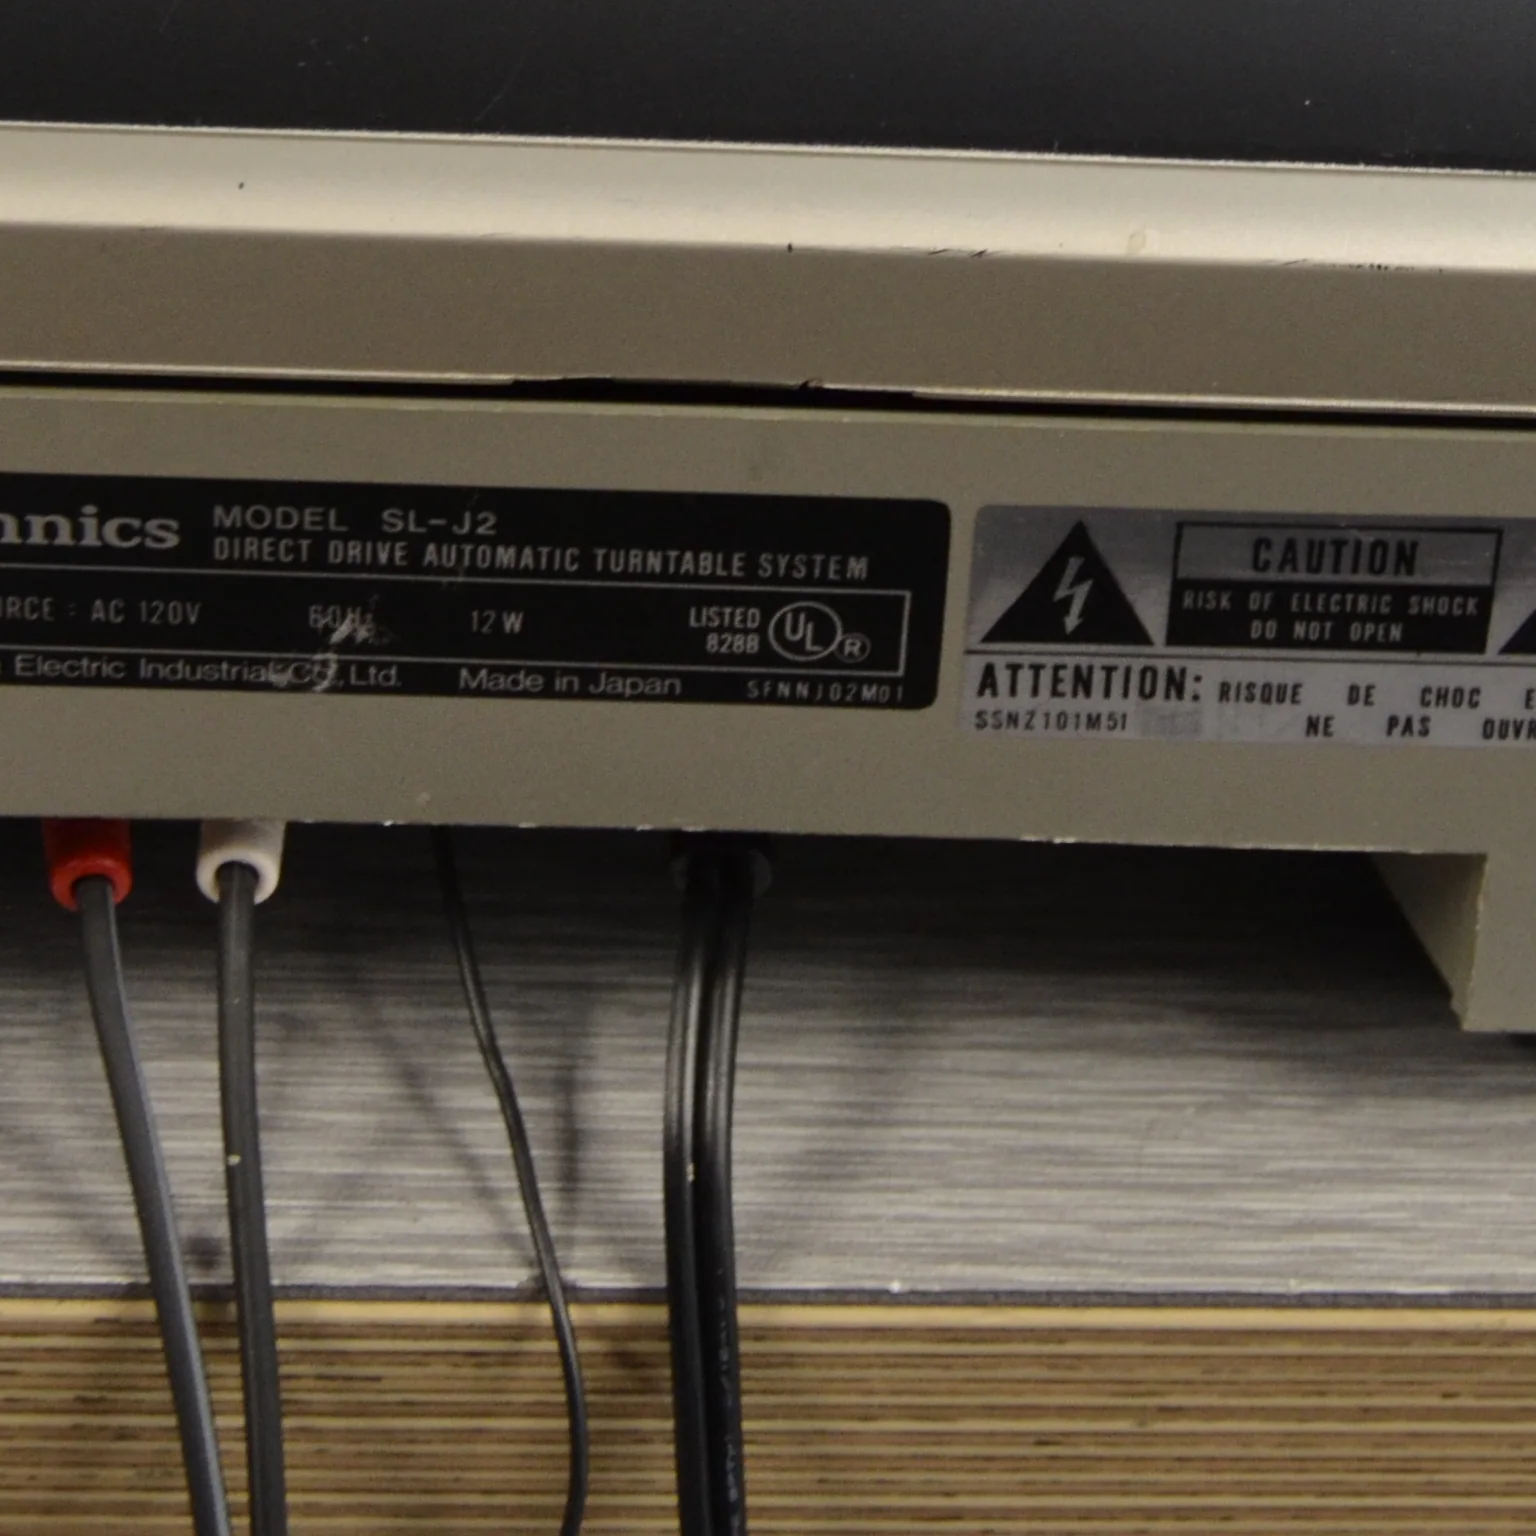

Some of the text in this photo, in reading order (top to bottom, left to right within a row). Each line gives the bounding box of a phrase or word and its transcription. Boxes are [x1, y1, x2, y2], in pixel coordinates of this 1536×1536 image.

[213, 505, 497, 535] MODEL SL-J2
[213, 536, 869, 581] DIRECT DRIVE AUTOMATIC TURNTABLE SYSTEM
[1251, 536, 1420, 577] CAUTION
[91, 598, 125, 624] AC
[139, 599, 202, 626] 120V
[689, 605, 762, 629] LISTED
[1182, 589, 1481, 616] RISK OF ELECTRIC SHOCK
[1250, 618, 1404, 643] DO NOT OPEN
[14, 653, 126, 679] Electric
[350, 663, 403, 688] Ltd.
[459, 667, 545, 693] Made
[554, 669, 580, 693] in
[588, 671, 682, 698] Japan
[976, 662, 1203, 702] ATTENTION:
[1218, 680, 1304, 706] RISQUE
[1347, 683, 1376, 707] DE
[1419, 686, 1482, 710] CHOC
[1305, 715, 1335, 738] NE
[1385, 715, 1432, 738] PAS
